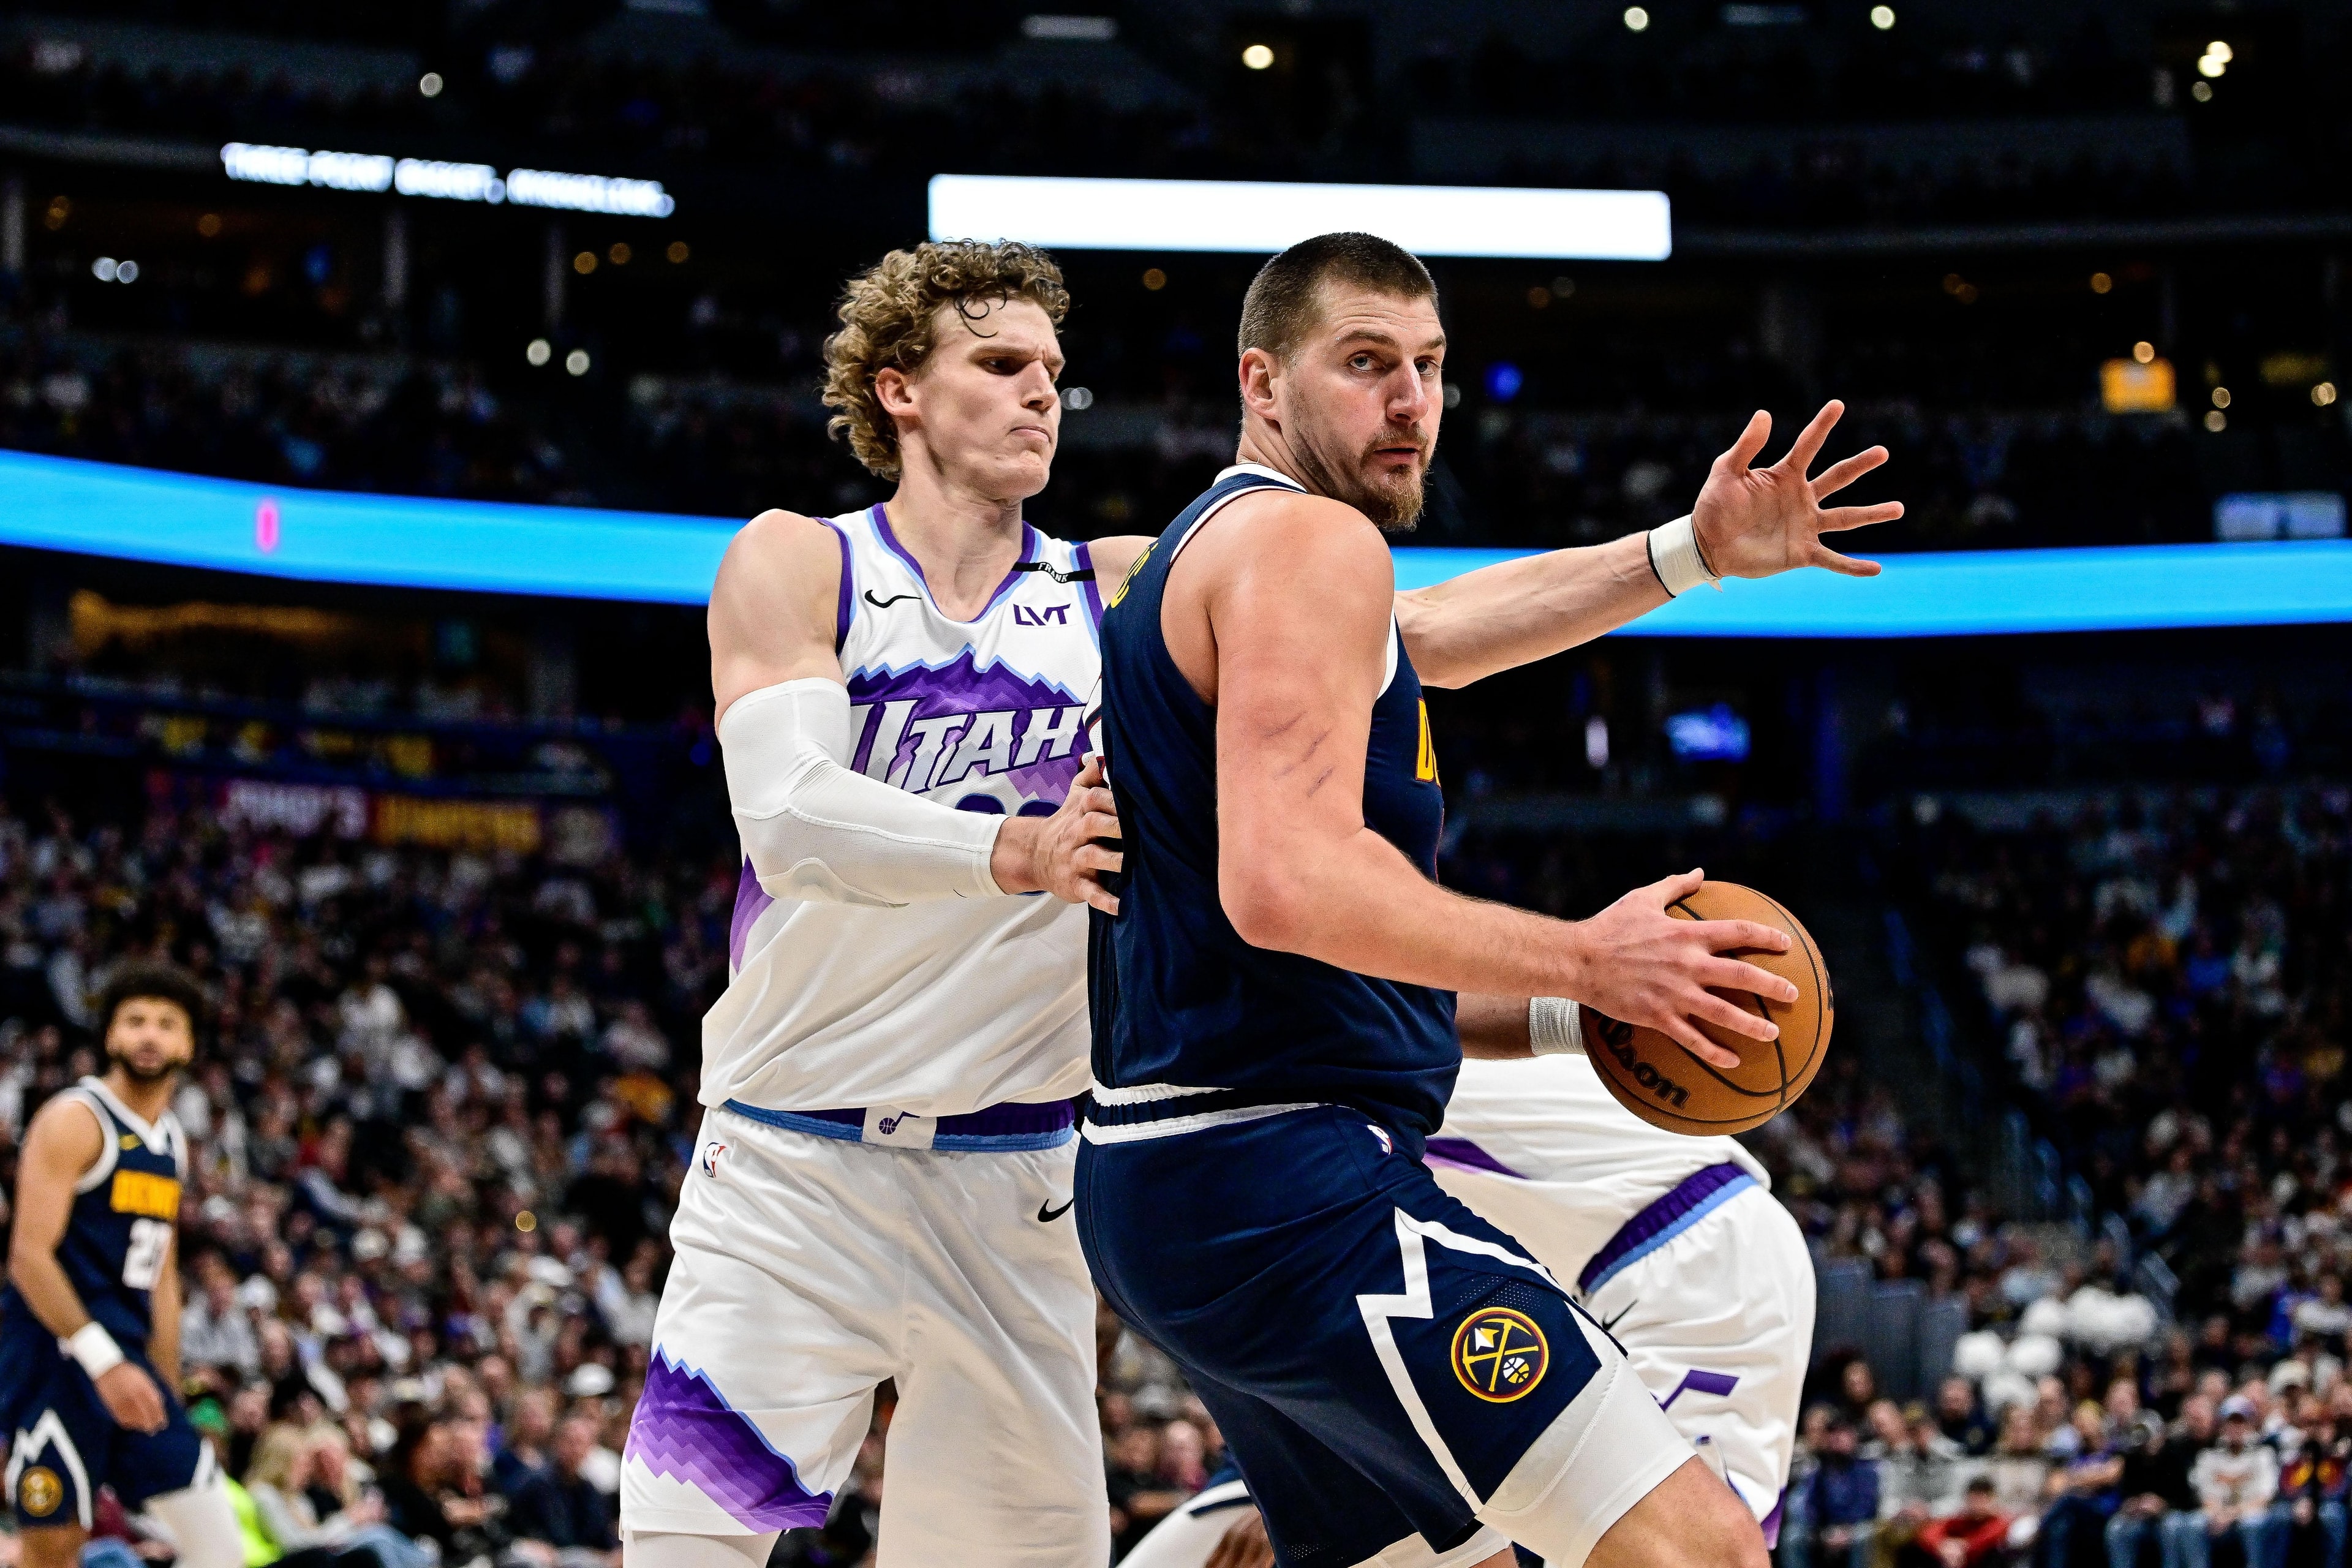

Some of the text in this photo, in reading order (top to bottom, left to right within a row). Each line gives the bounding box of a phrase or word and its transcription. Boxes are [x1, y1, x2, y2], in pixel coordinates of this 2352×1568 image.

[1038, 562, 1069, 582] FRANK
[1013, 603, 1071, 626] LVT
[850, 699, 1085, 794] UTAH
